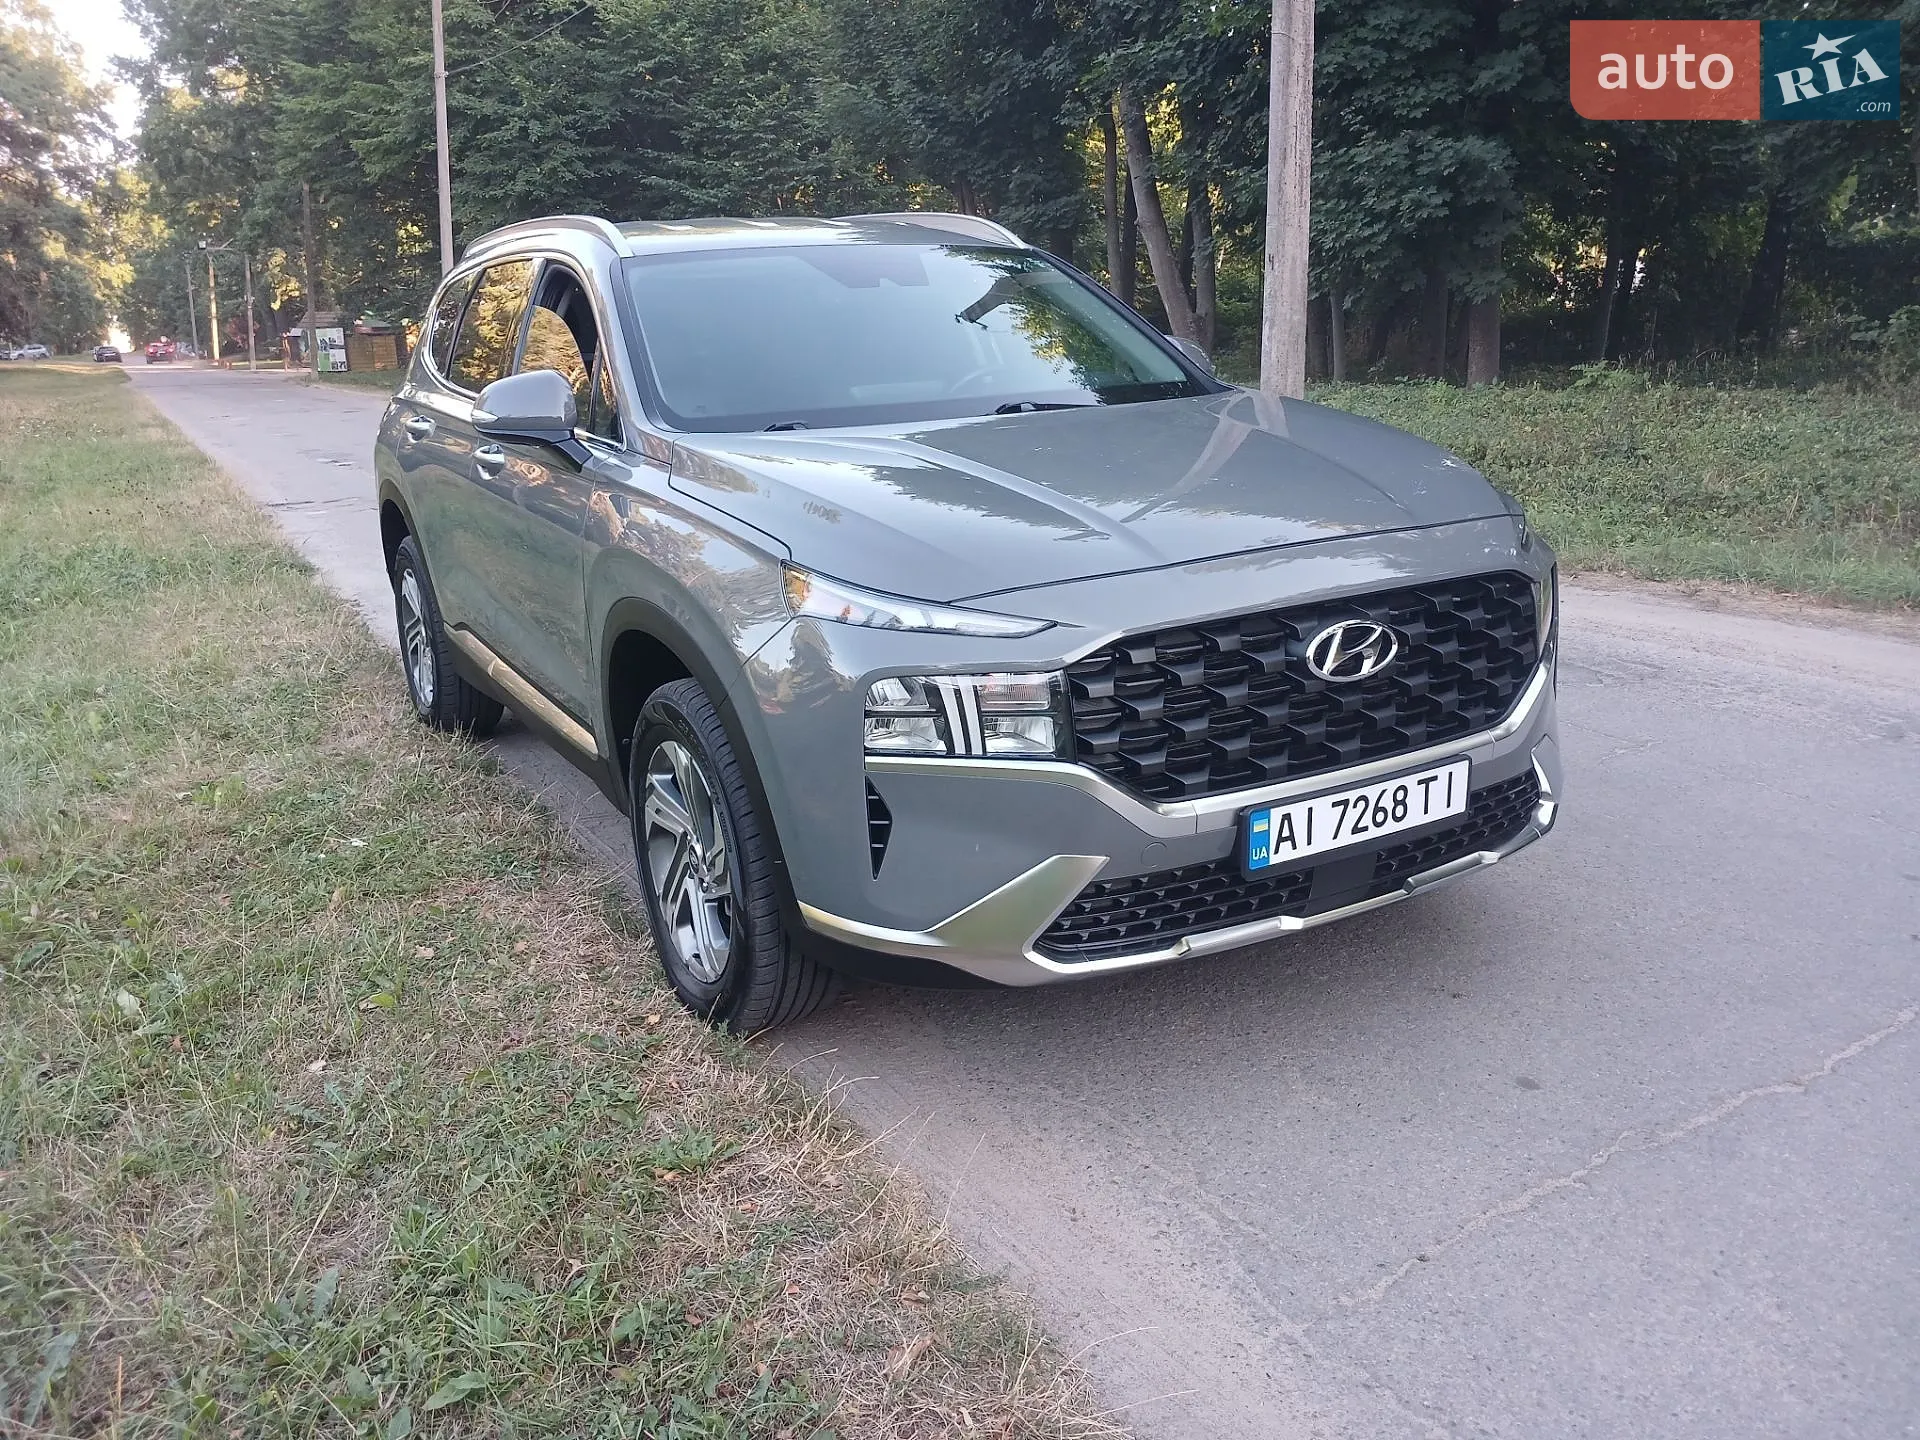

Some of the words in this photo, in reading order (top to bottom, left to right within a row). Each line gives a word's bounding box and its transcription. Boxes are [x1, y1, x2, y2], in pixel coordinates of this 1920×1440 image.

[1273, 807, 1313, 855] AI
[1331, 784, 1409, 841] 7268
[1416, 771, 1453, 816] TI
[1252, 848, 1269, 860] UA
